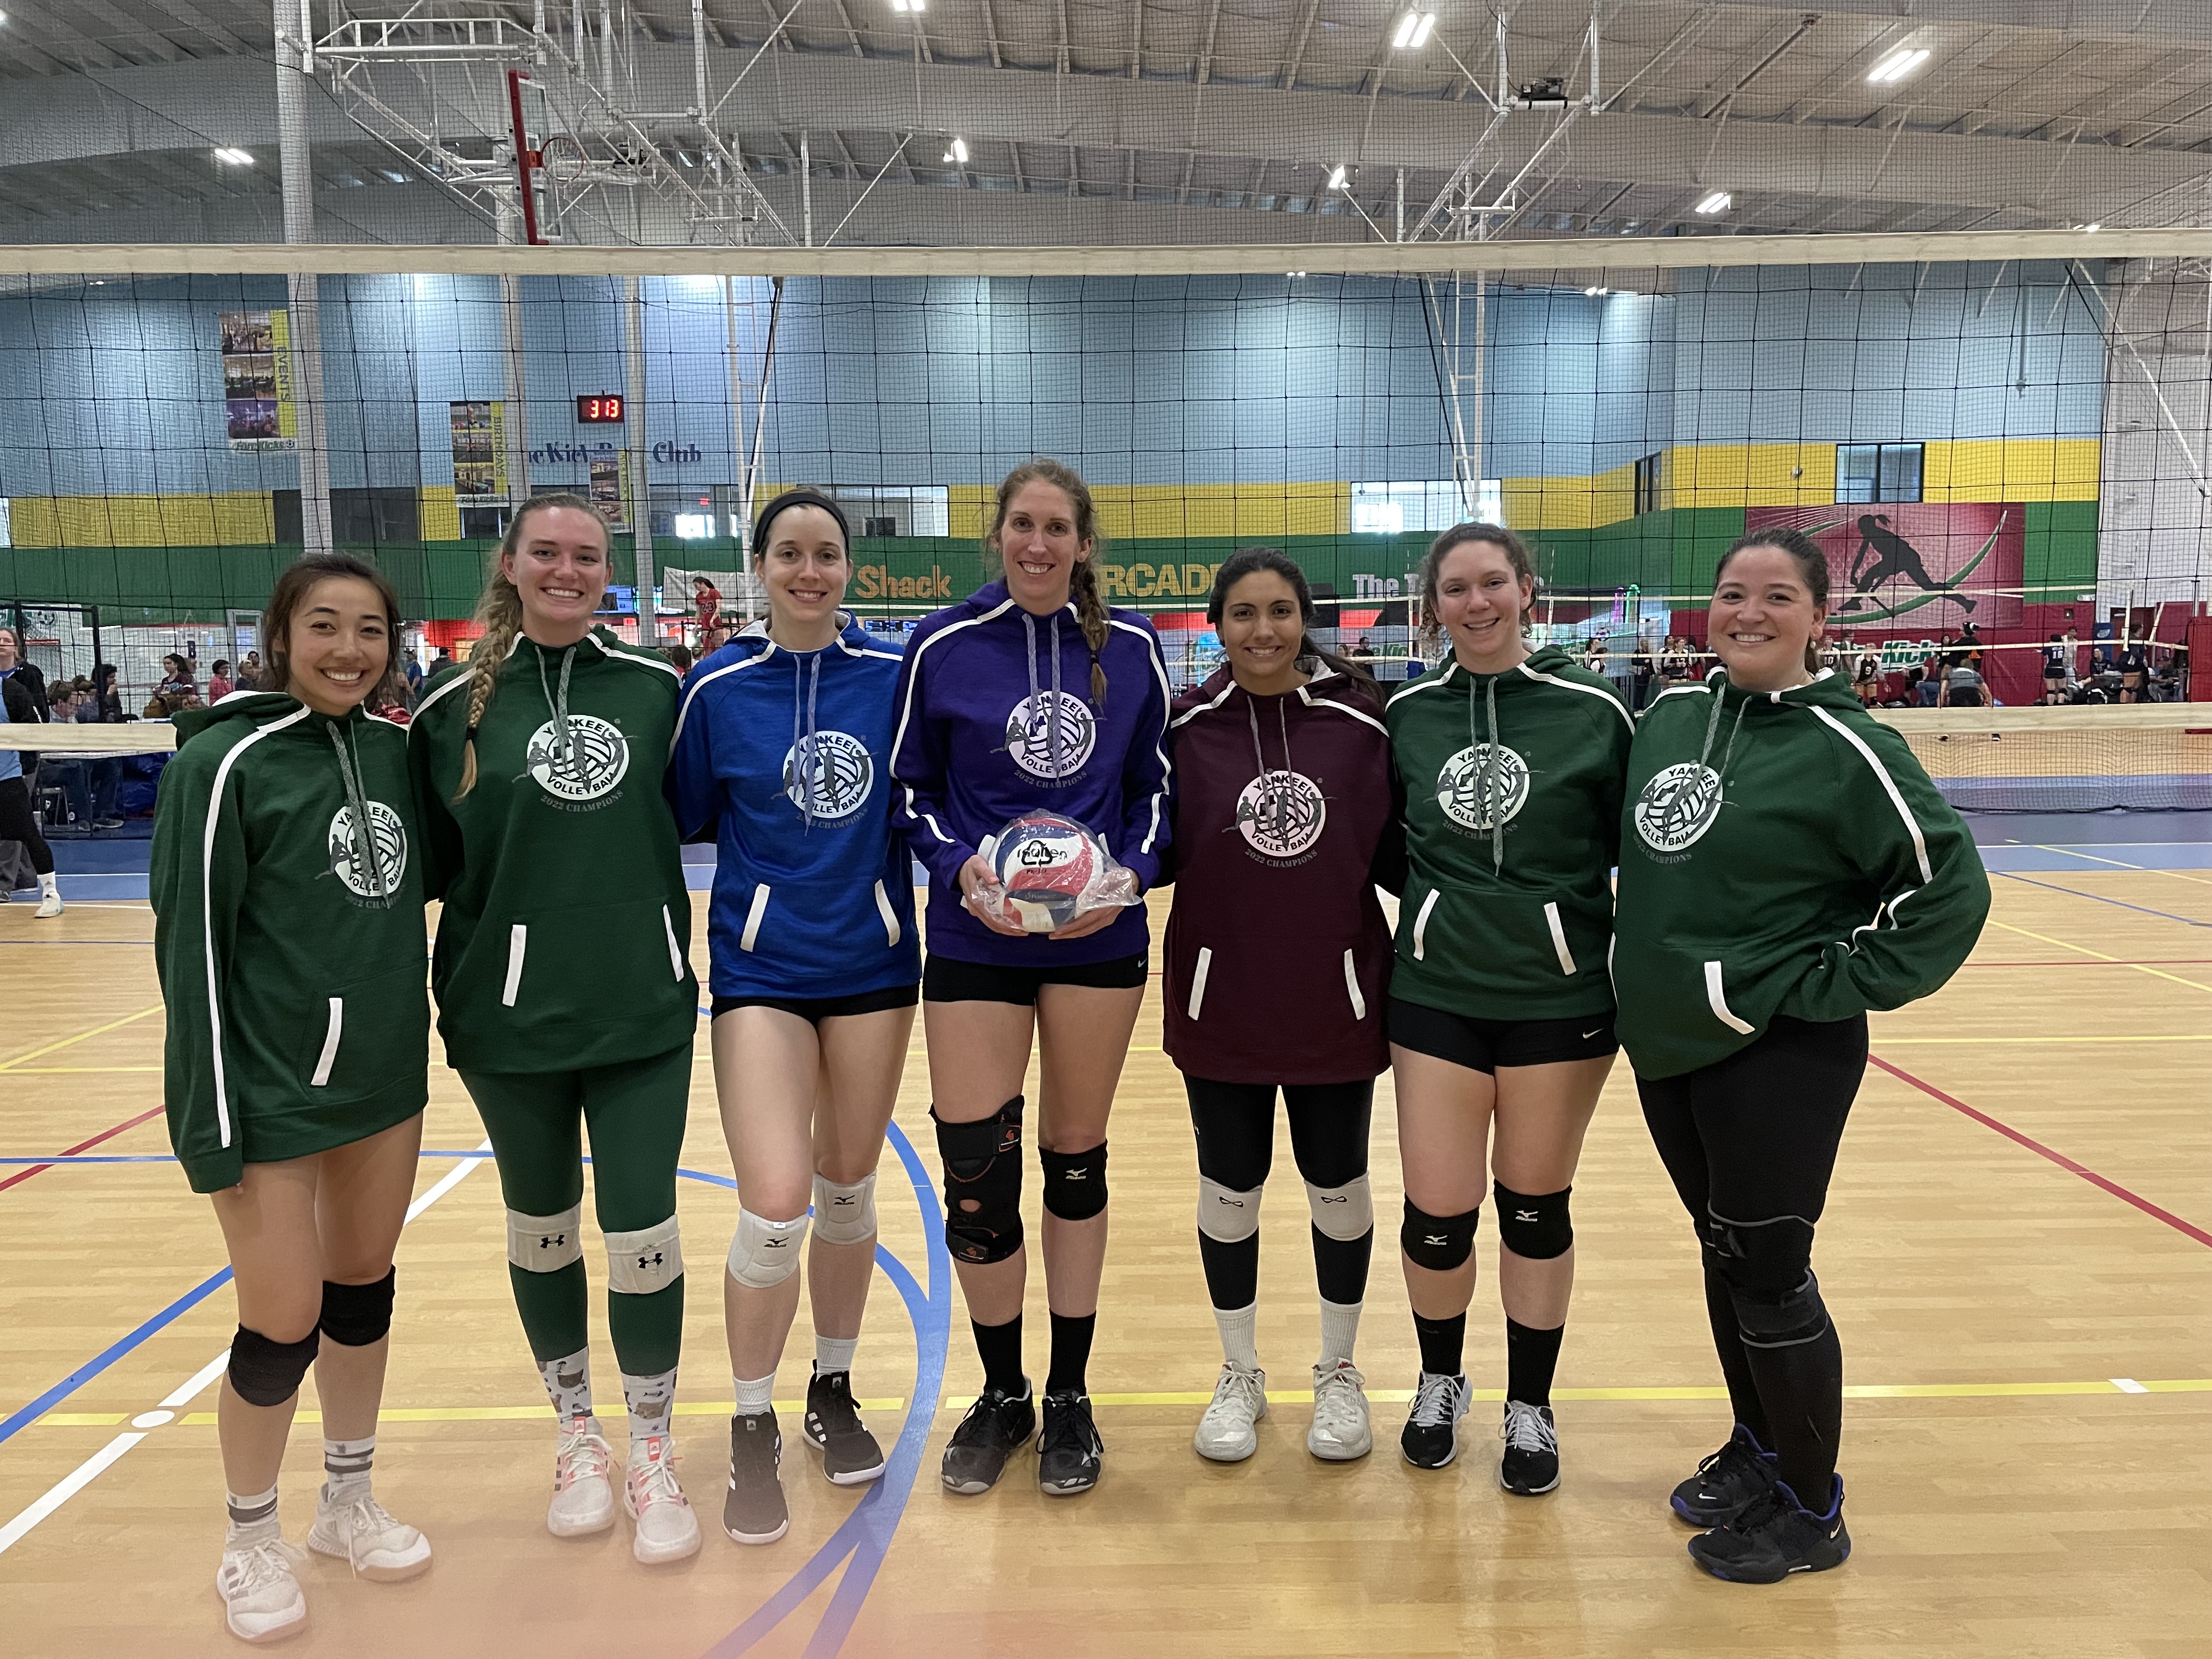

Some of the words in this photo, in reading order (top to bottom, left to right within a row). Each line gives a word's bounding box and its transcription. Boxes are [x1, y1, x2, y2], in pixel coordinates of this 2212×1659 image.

[278, 346, 290, 402] EVENTS
[652, 441, 702, 462] Club
[855, 565, 952, 598] Shack
[1099, 563, 1223, 597] RCAD
[1352, 574, 1399, 599] The
[1881, 641, 1933, 664] Kick
[1023, 696, 1079, 712] YNEE
[543, 719, 605, 736] YKEE
[799, 735, 853, 753] YNKEE
[1021, 753, 1080, 773] VOLLEBAL
[1457, 748, 1514, 764] YANEE
[1014, 770, 1034, 785] 2022
[1036, 770, 1087, 789] CHAMPIONS
[1669, 768, 1716, 788] YANEE
[540, 795, 564, 809] 2022
[566, 789, 623, 812] CHAMPIONS
[801, 792, 860, 813] VLLEYBAL
[338, 806, 389, 826] YAEE
[797, 812, 817, 826] 22
[1449, 805, 1509, 824] VOLLYBL
[1245, 849, 1265, 864] 2022
[1267, 849, 1317, 867] CHAMPIONS
[1646, 849, 1692, 864] CHAMPIONS
[349, 866, 401, 890] VOLEBAL
